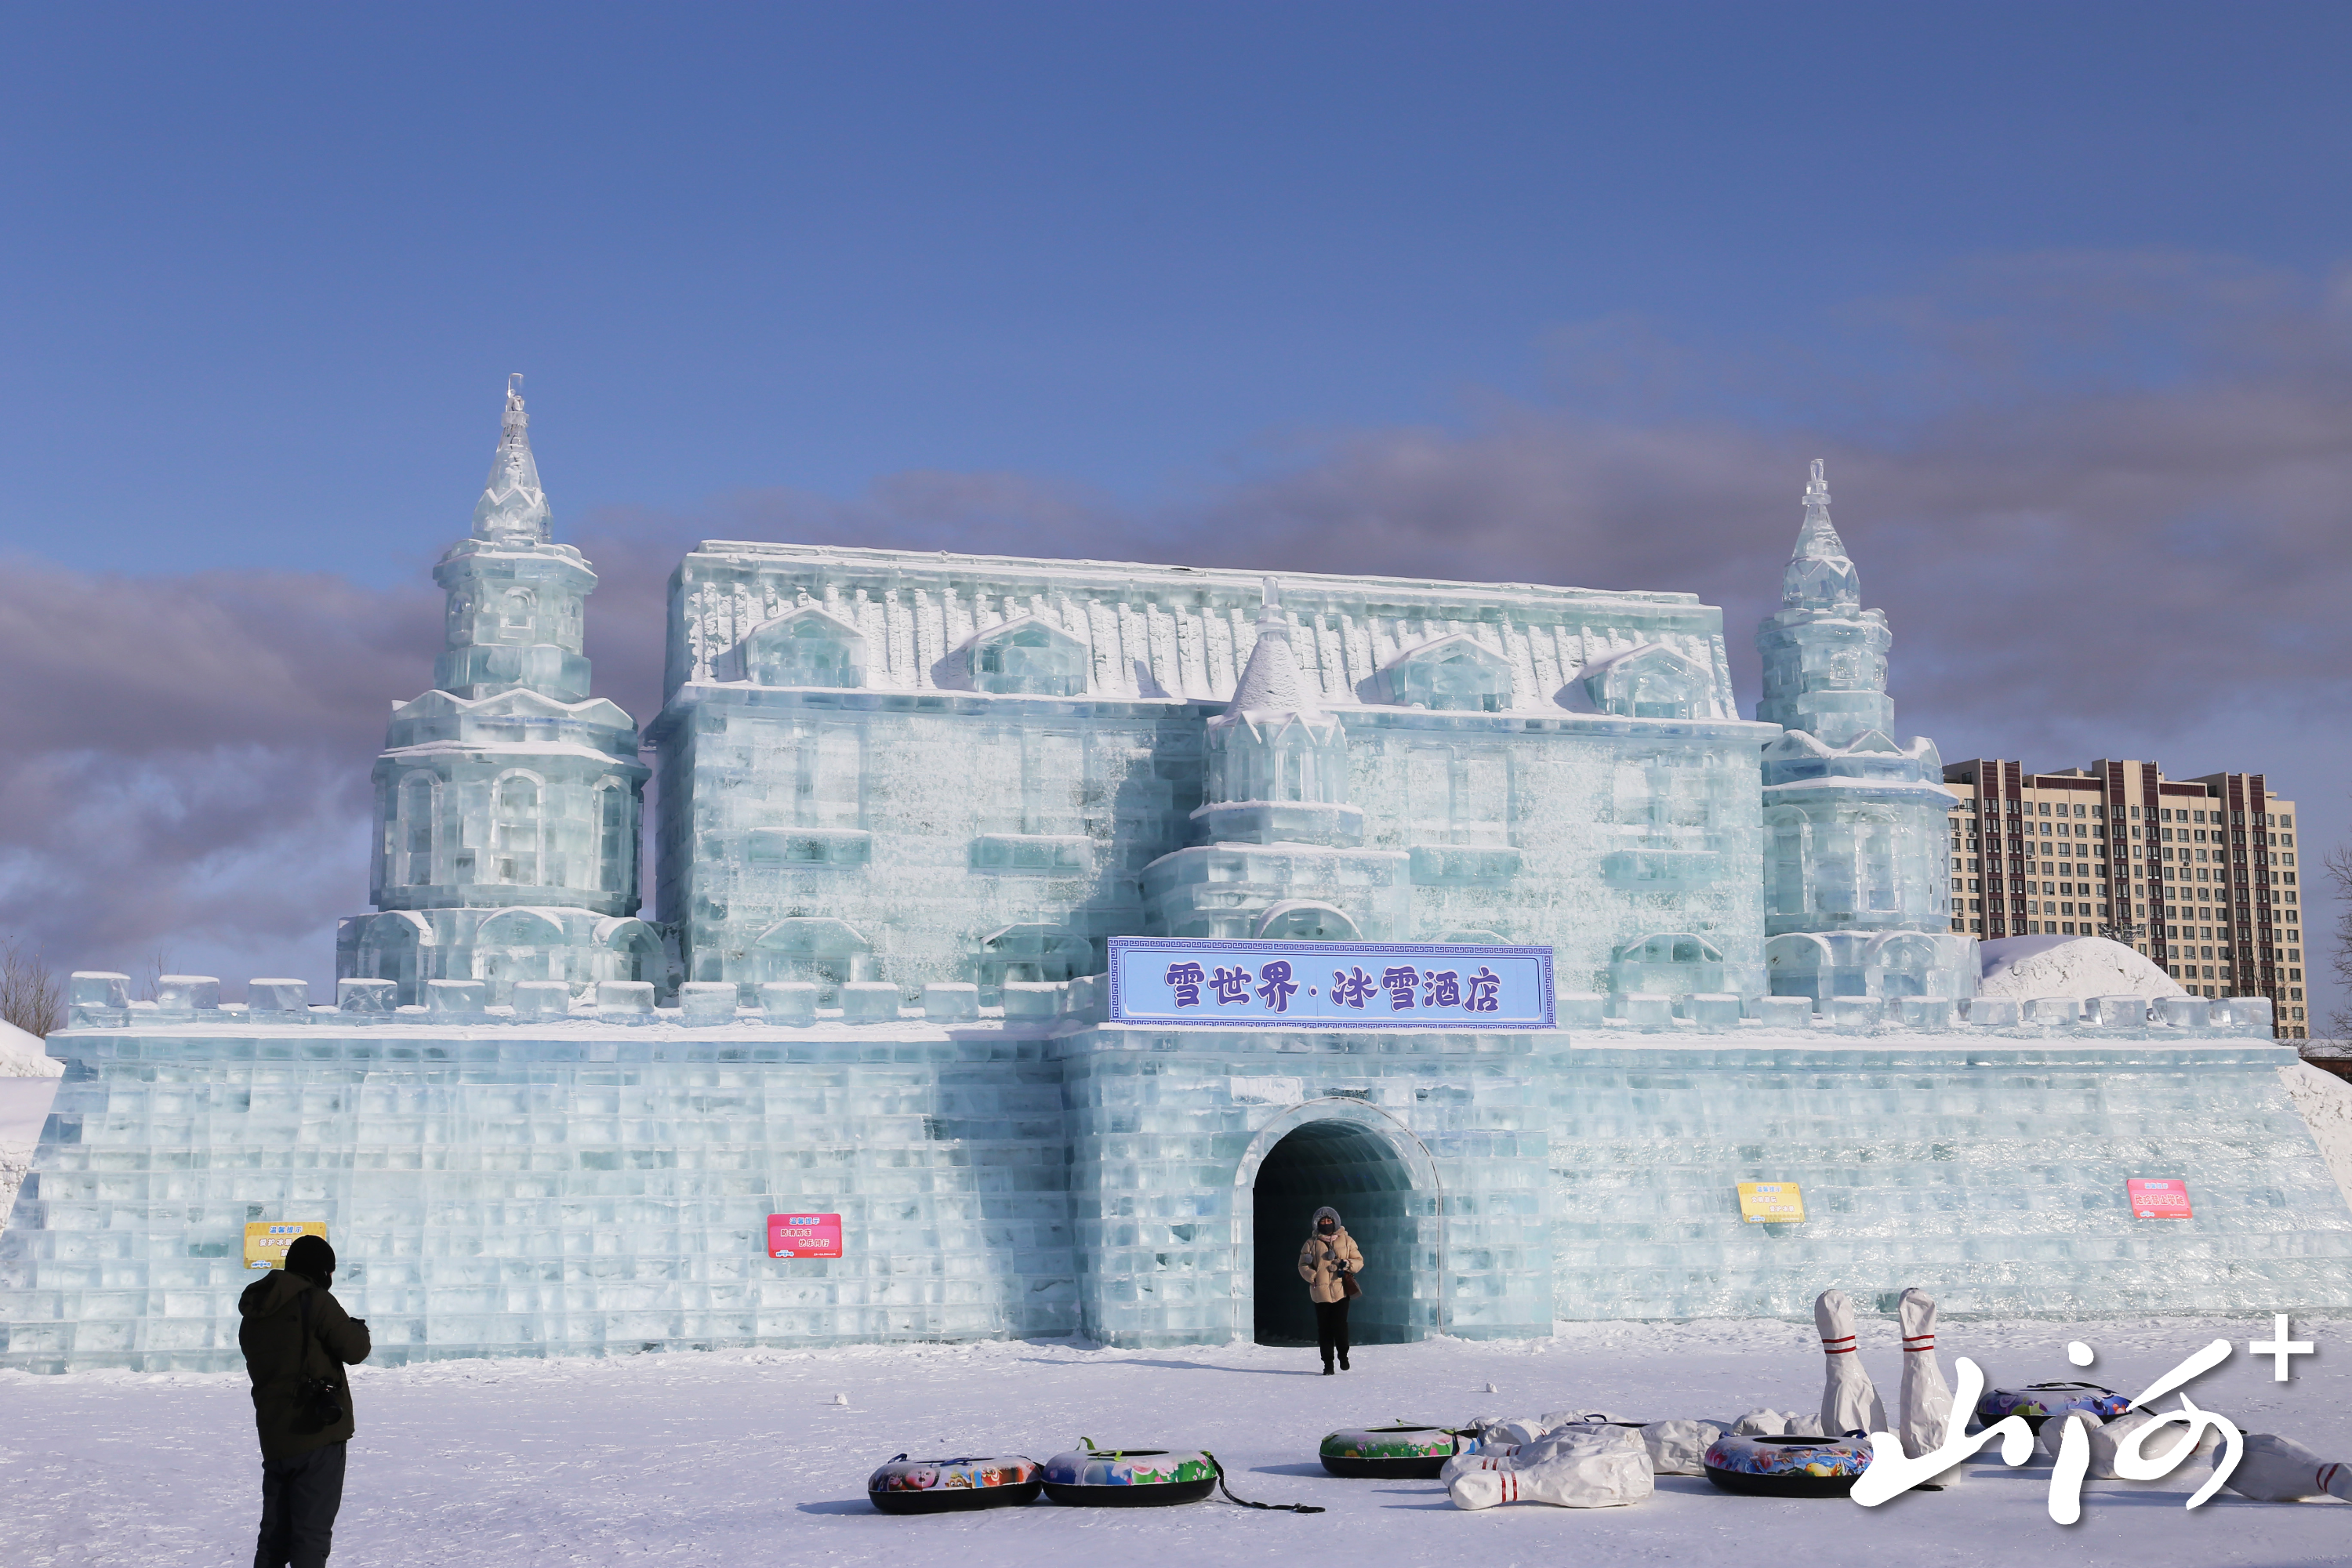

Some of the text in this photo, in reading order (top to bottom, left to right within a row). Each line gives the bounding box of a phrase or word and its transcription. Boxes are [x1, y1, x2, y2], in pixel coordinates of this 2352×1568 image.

[1164, 960, 1502, 1014] 雪世界·冰雪酒店
[2134, 1194, 2185, 1205] 危险禁止攀爬
[259, 1238, 293, 1247] 爱护冰景
